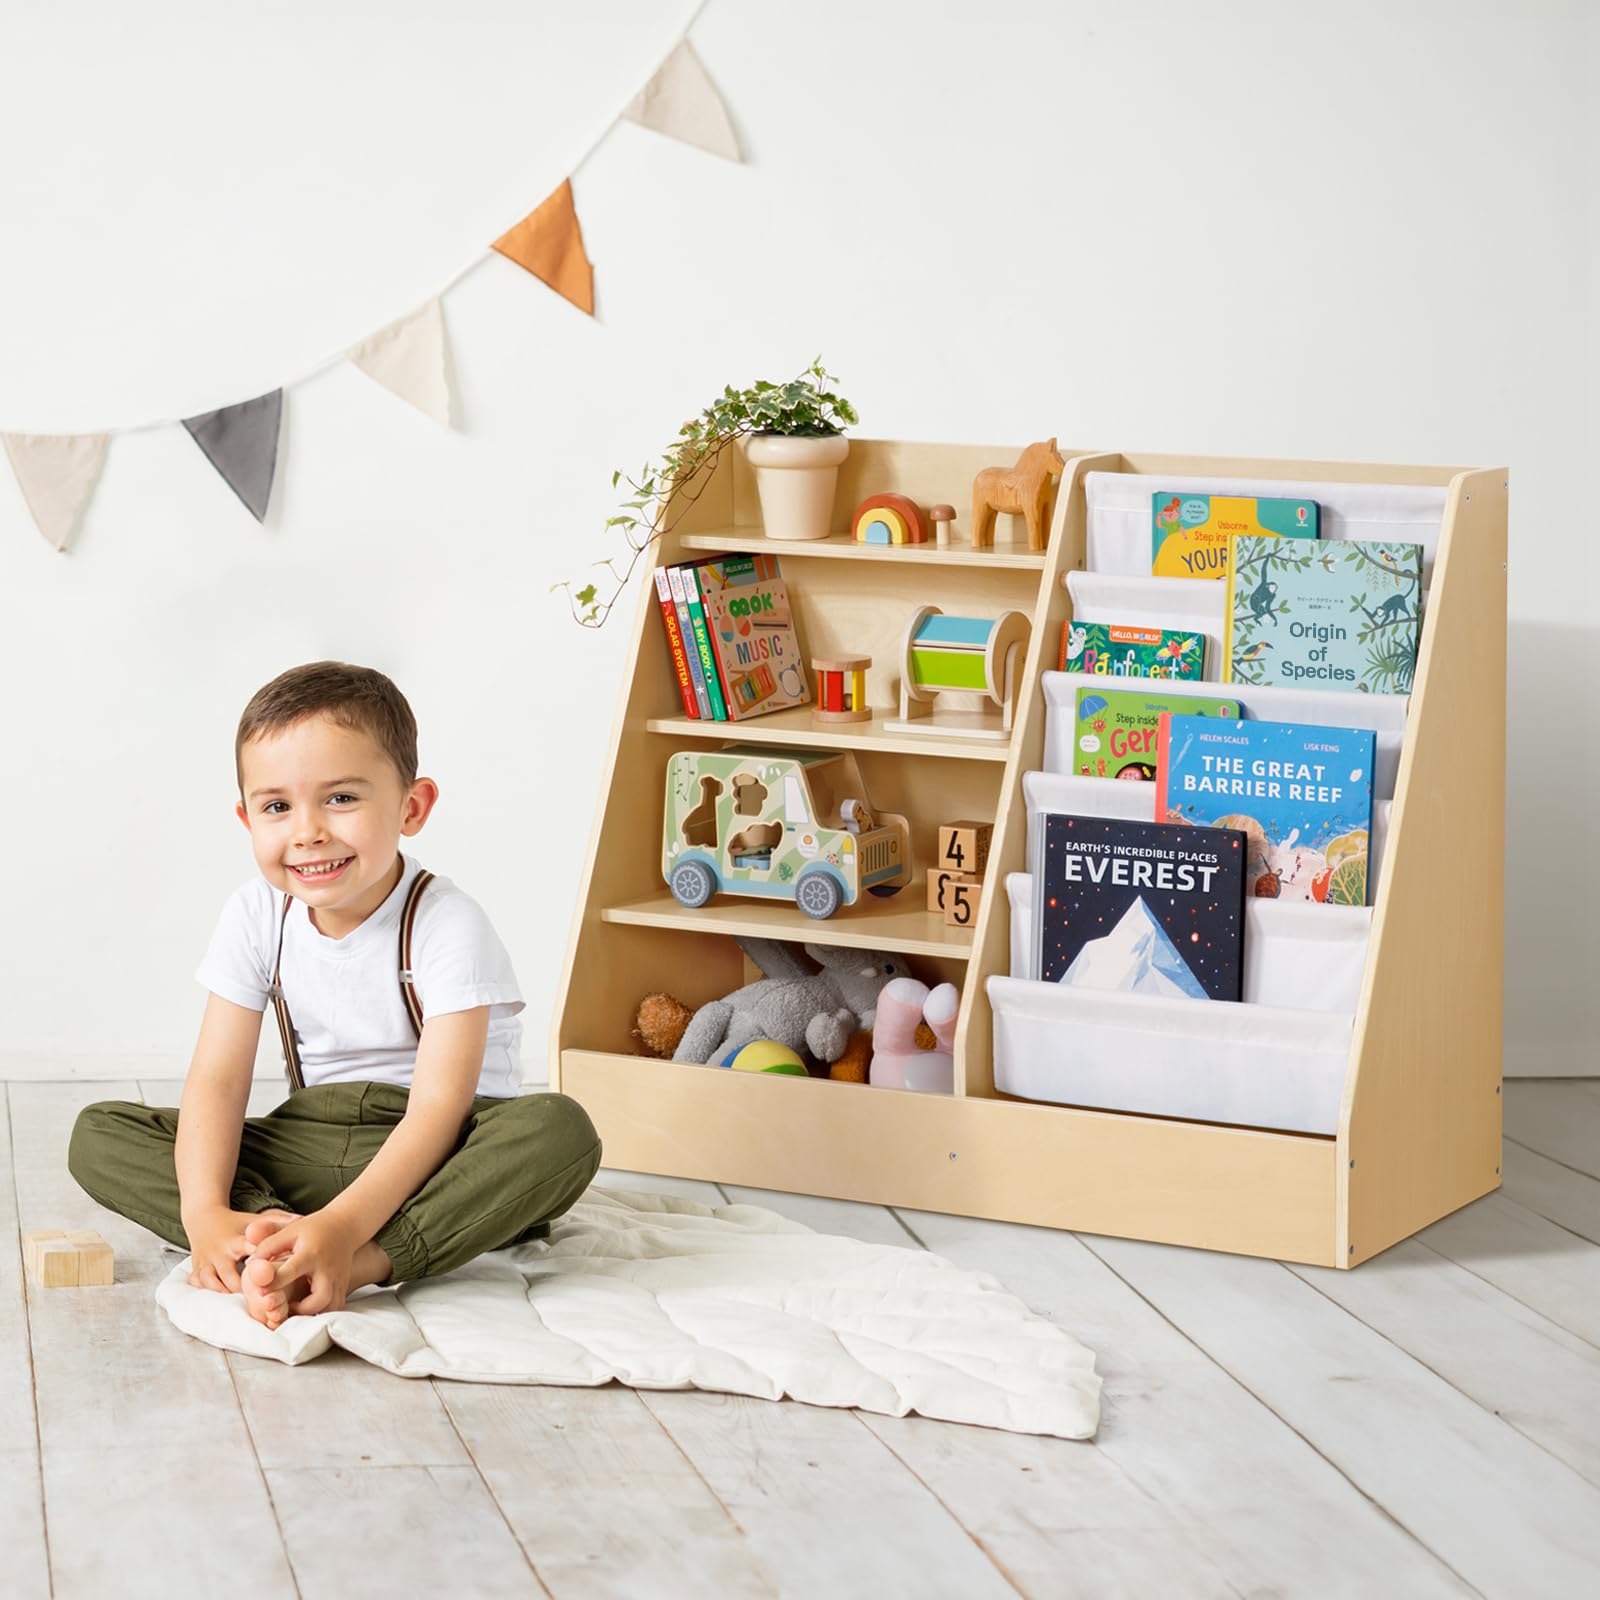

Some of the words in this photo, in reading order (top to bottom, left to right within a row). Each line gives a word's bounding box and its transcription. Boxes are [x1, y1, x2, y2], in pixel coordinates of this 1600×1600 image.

[1217, 520, 1248, 531] Usborne
[1194, 530, 1214, 545] Step
[1216, 532, 1228, 543] ins
[695, 628, 705, 643] MY
[1289, 622, 1347, 643] Origin
[666, 615, 680, 647] SOLAR
[674, 648, 688, 687] SYSTEM
[699, 644, 712, 670] BODY
[735, 634, 783, 665] MUSIC
[1308, 646, 1328, 662] of
[1281, 660, 1356, 681] Species
[1116, 712, 1135, 728] Step
[1110, 728, 1158, 758] Ger
[1223, 735, 1249, 745] SCALES
[1321, 744, 1340, 753] FENG
[1201, 755, 1244, 775] THE
[1252, 760, 1326, 782] GREAT
[1184, 774, 1281, 798] BARRIER
[1289, 783, 1343, 803] REEF
[945, 830, 965, 868] 4
[1114, 846, 1175, 860] INCREDIBLE
[1178, 852, 1218, 863] PLACES
[1065, 854, 1218, 893] EVEREST
[953, 886, 971, 924] 5
